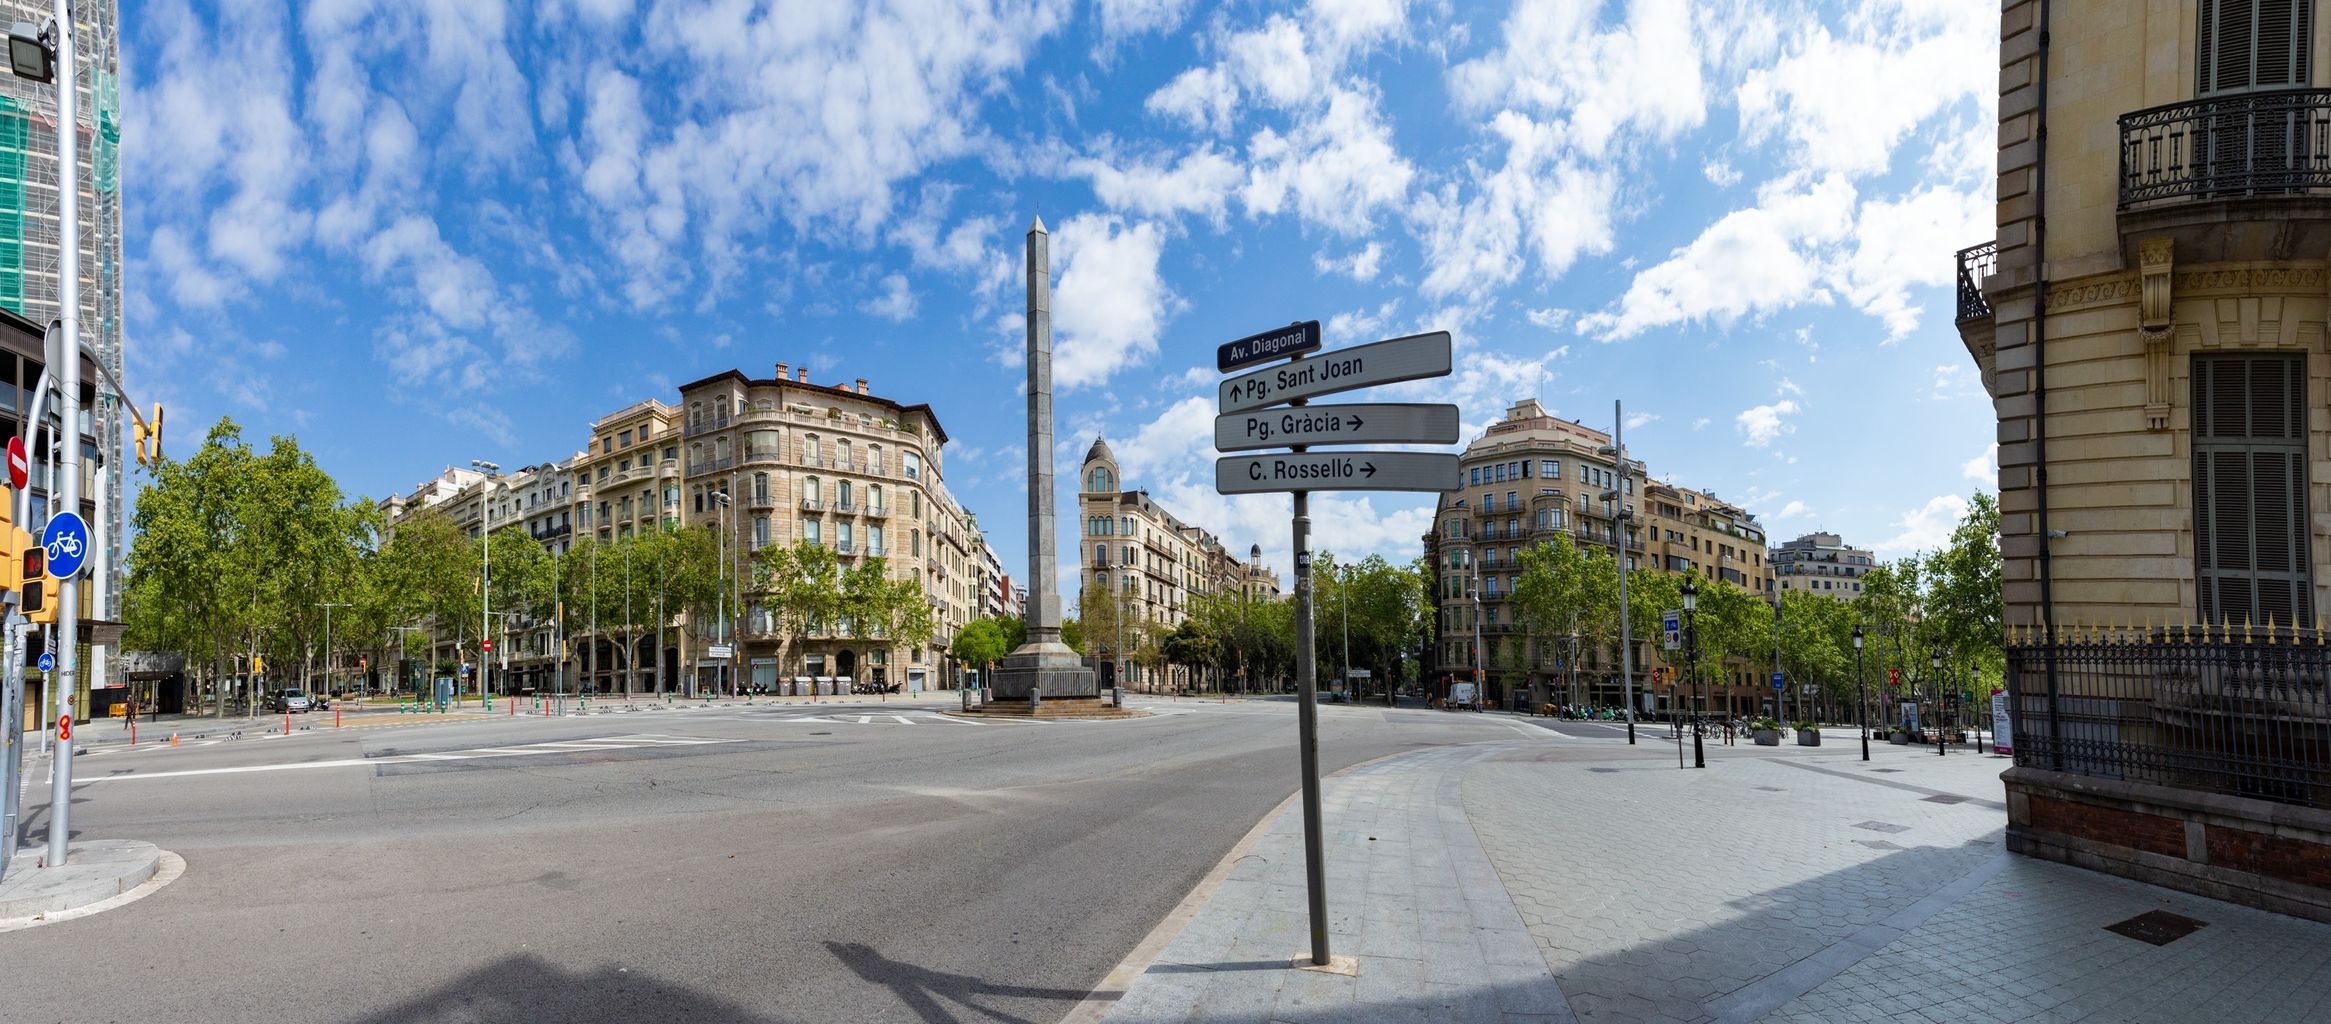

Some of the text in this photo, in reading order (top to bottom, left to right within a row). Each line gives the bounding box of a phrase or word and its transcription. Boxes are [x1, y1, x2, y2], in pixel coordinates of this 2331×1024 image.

[1230, 328, 1306, 361] Av. Diagonal
[1246, 358, 1363, 400] Pg. Sant Joan
[1247, 412, 1340, 440] Pg. Gràcia
[1249, 458, 1353, 480] C. Rosselló
